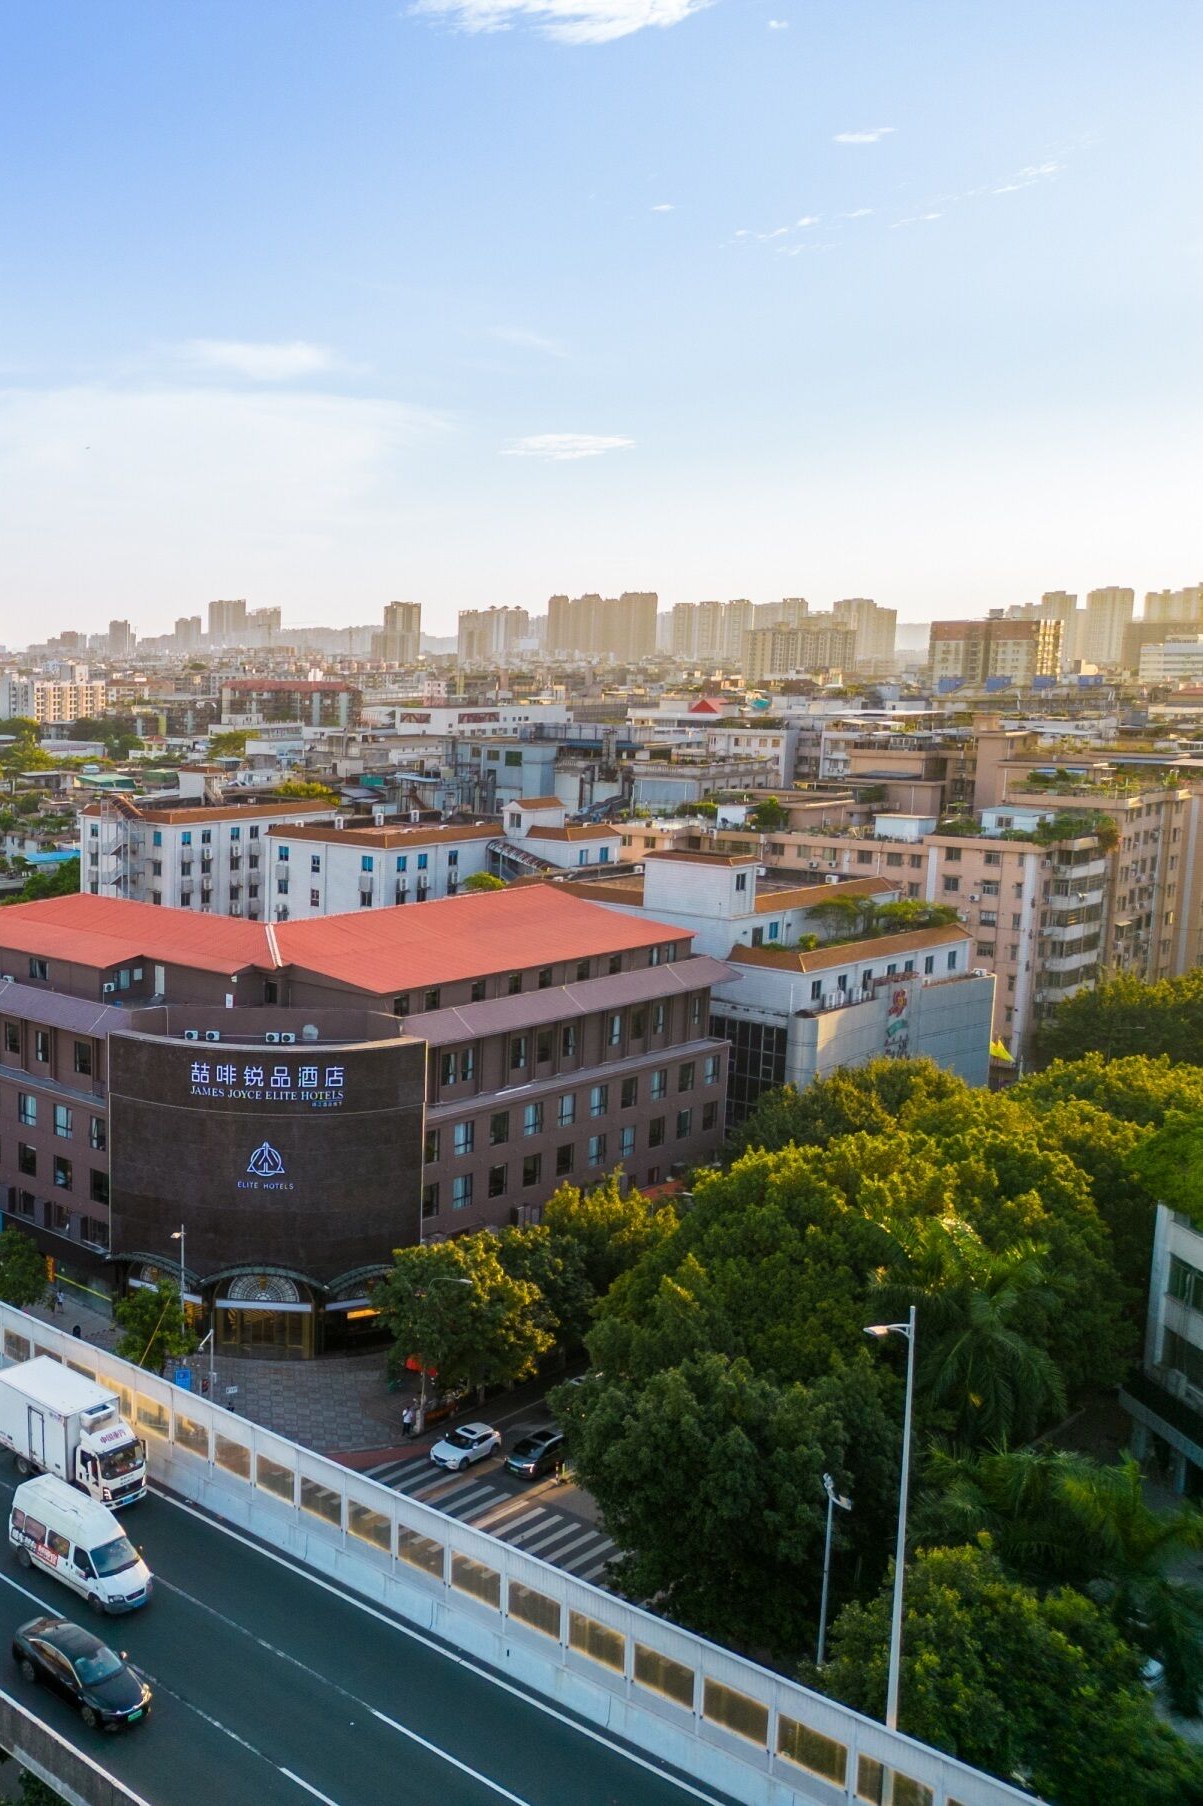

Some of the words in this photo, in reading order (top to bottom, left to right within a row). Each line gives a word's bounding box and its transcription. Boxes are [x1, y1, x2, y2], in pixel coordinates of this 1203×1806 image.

[190, 1061, 345, 1088] 喆啡锐品酒店
[190, 1085, 225, 1097] JAMES
[227, 1089, 262, 1100] JOYCE
[265, 1091, 297, 1100] ELITE
[301, 1090, 344, 1100] HOTELS
[237, 1181, 258, 1189] ELITE
